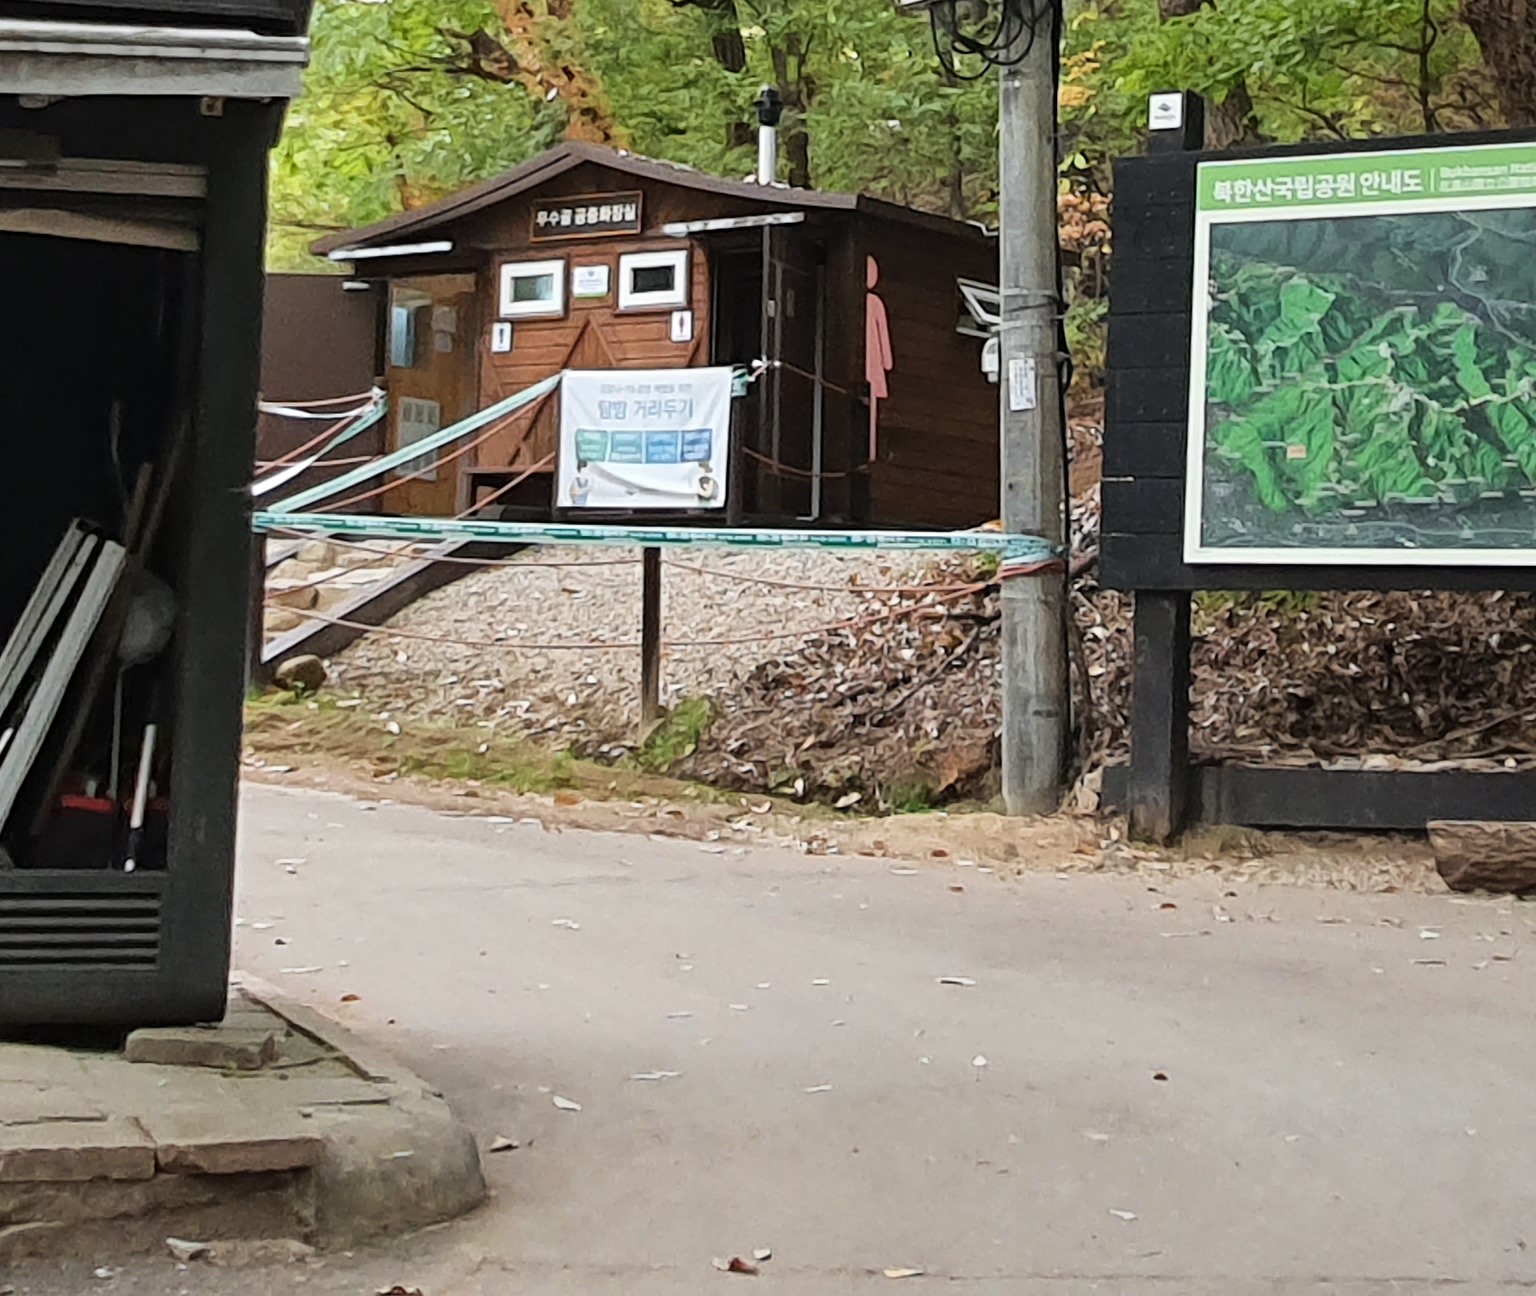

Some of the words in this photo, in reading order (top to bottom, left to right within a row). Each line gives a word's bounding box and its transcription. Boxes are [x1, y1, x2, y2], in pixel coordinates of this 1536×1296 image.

[1213, 171, 1356, 205] 북한산국립공원
[1360, 168, 1424, 195] 안내도
[633, 398, 694, 420] 거리두기
